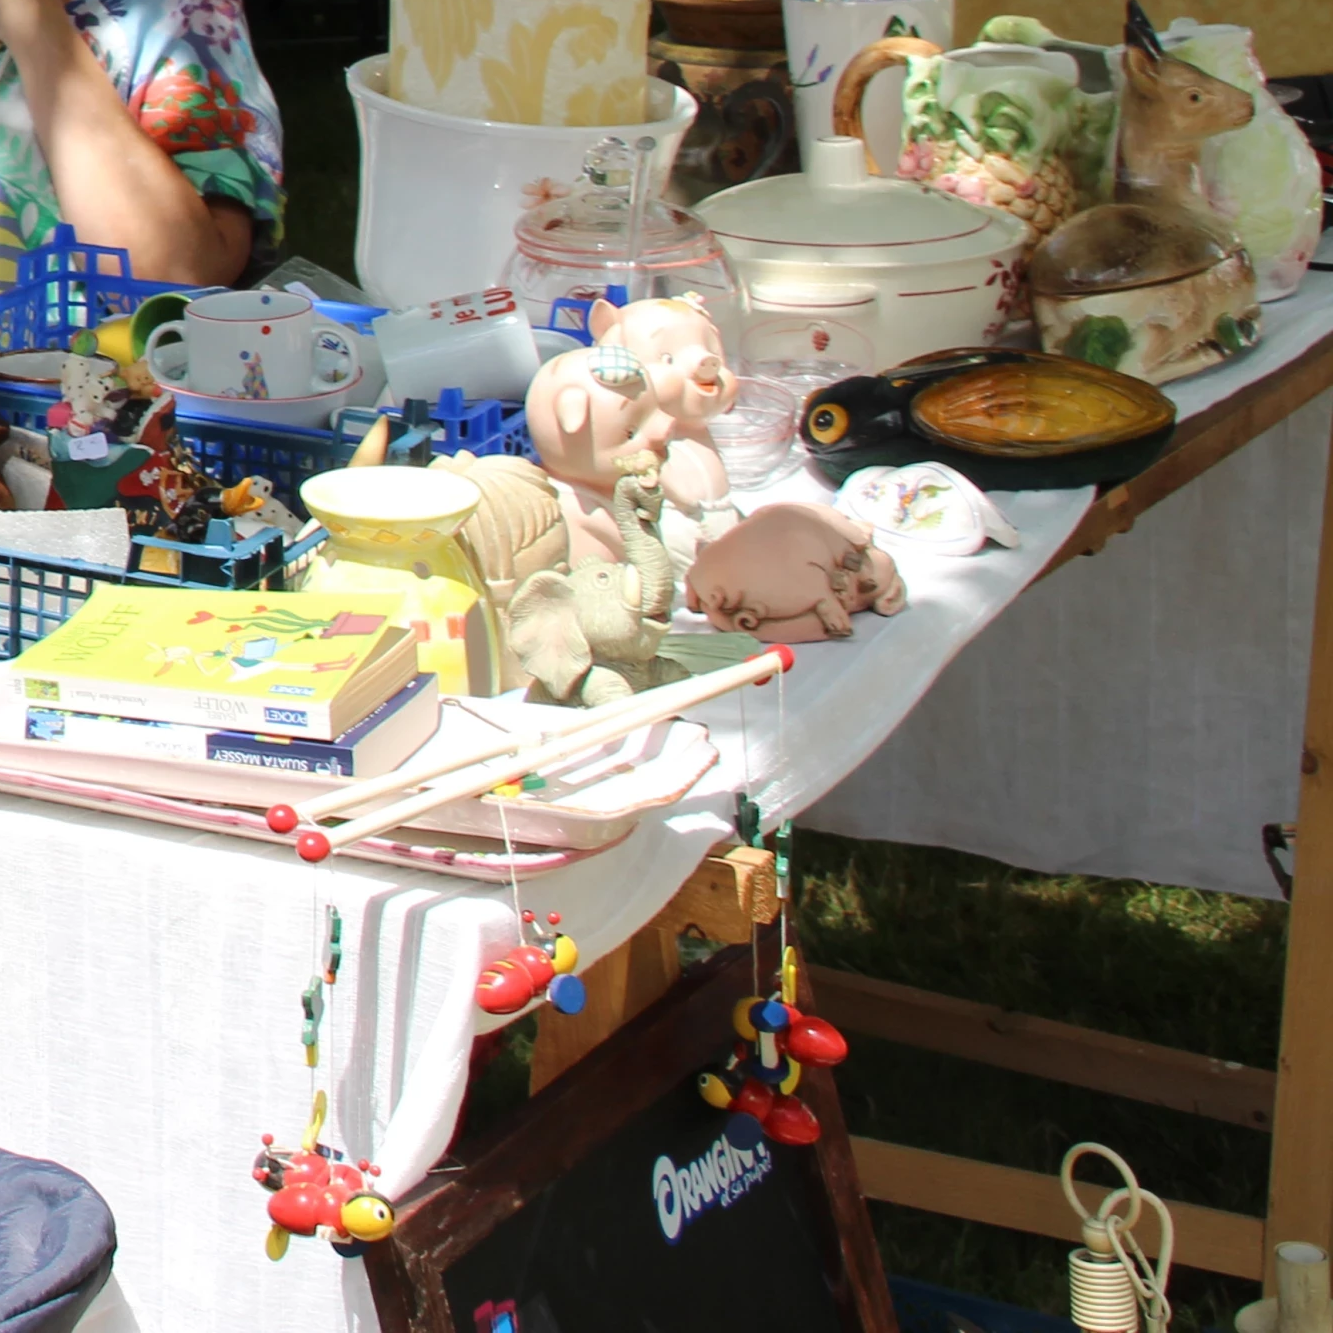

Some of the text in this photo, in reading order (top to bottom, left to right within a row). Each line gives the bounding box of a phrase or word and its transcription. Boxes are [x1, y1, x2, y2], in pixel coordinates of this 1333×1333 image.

[193, 696, 248, 715] WOLFF
[265, 710, 308, 725] POCKET
[213, 749, 261, 768] MASSEY
[262, 755, 308, 772] SUJATA
[653, 1133, 766, 1239] ORANGIN
